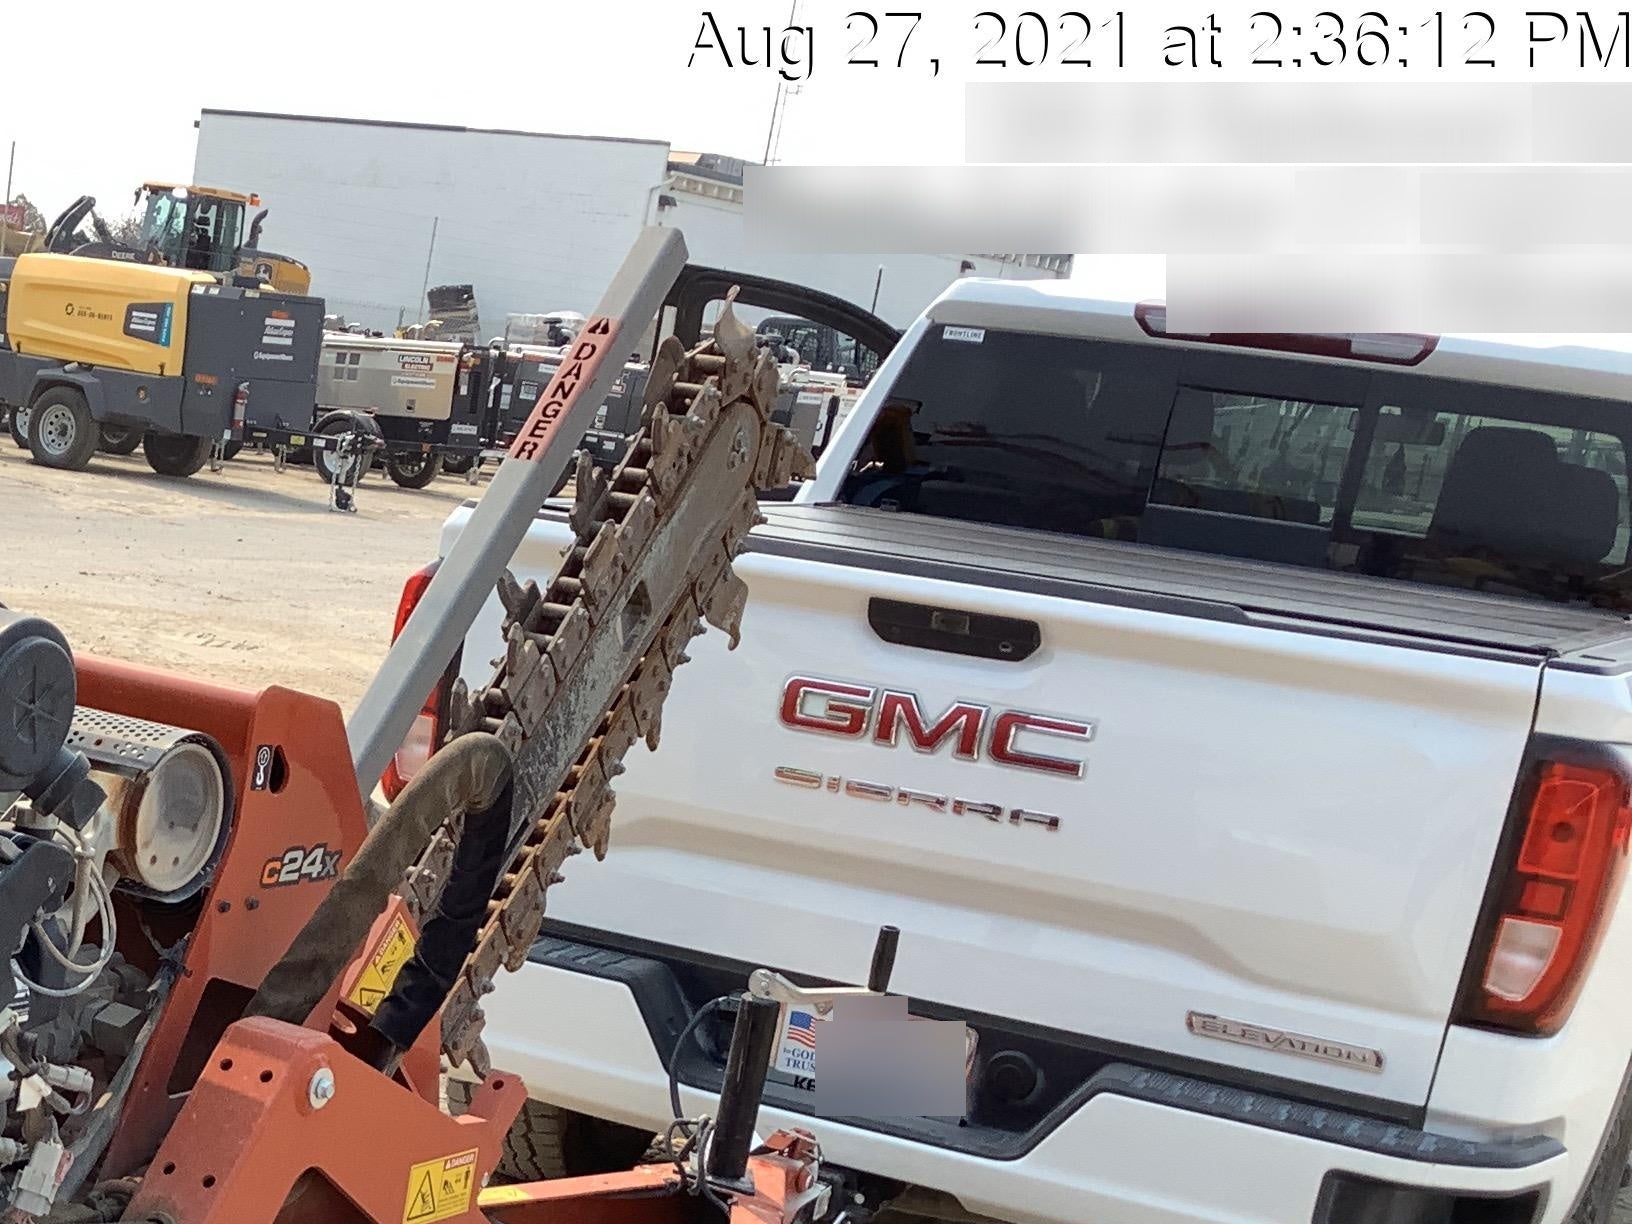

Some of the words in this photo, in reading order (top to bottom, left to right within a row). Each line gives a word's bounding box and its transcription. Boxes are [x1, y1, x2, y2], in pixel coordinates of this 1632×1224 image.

[111, 250, 135, 260] DEERE
[399, 355, 430, 364] LINCOLN
[515, 342, 597, 461] DANGER
[778, 673, 1098, 779] GMC
[773, 765, 1062, 832] SIERRA
[1200, 1018, 1369, 1064] ELEVATION
